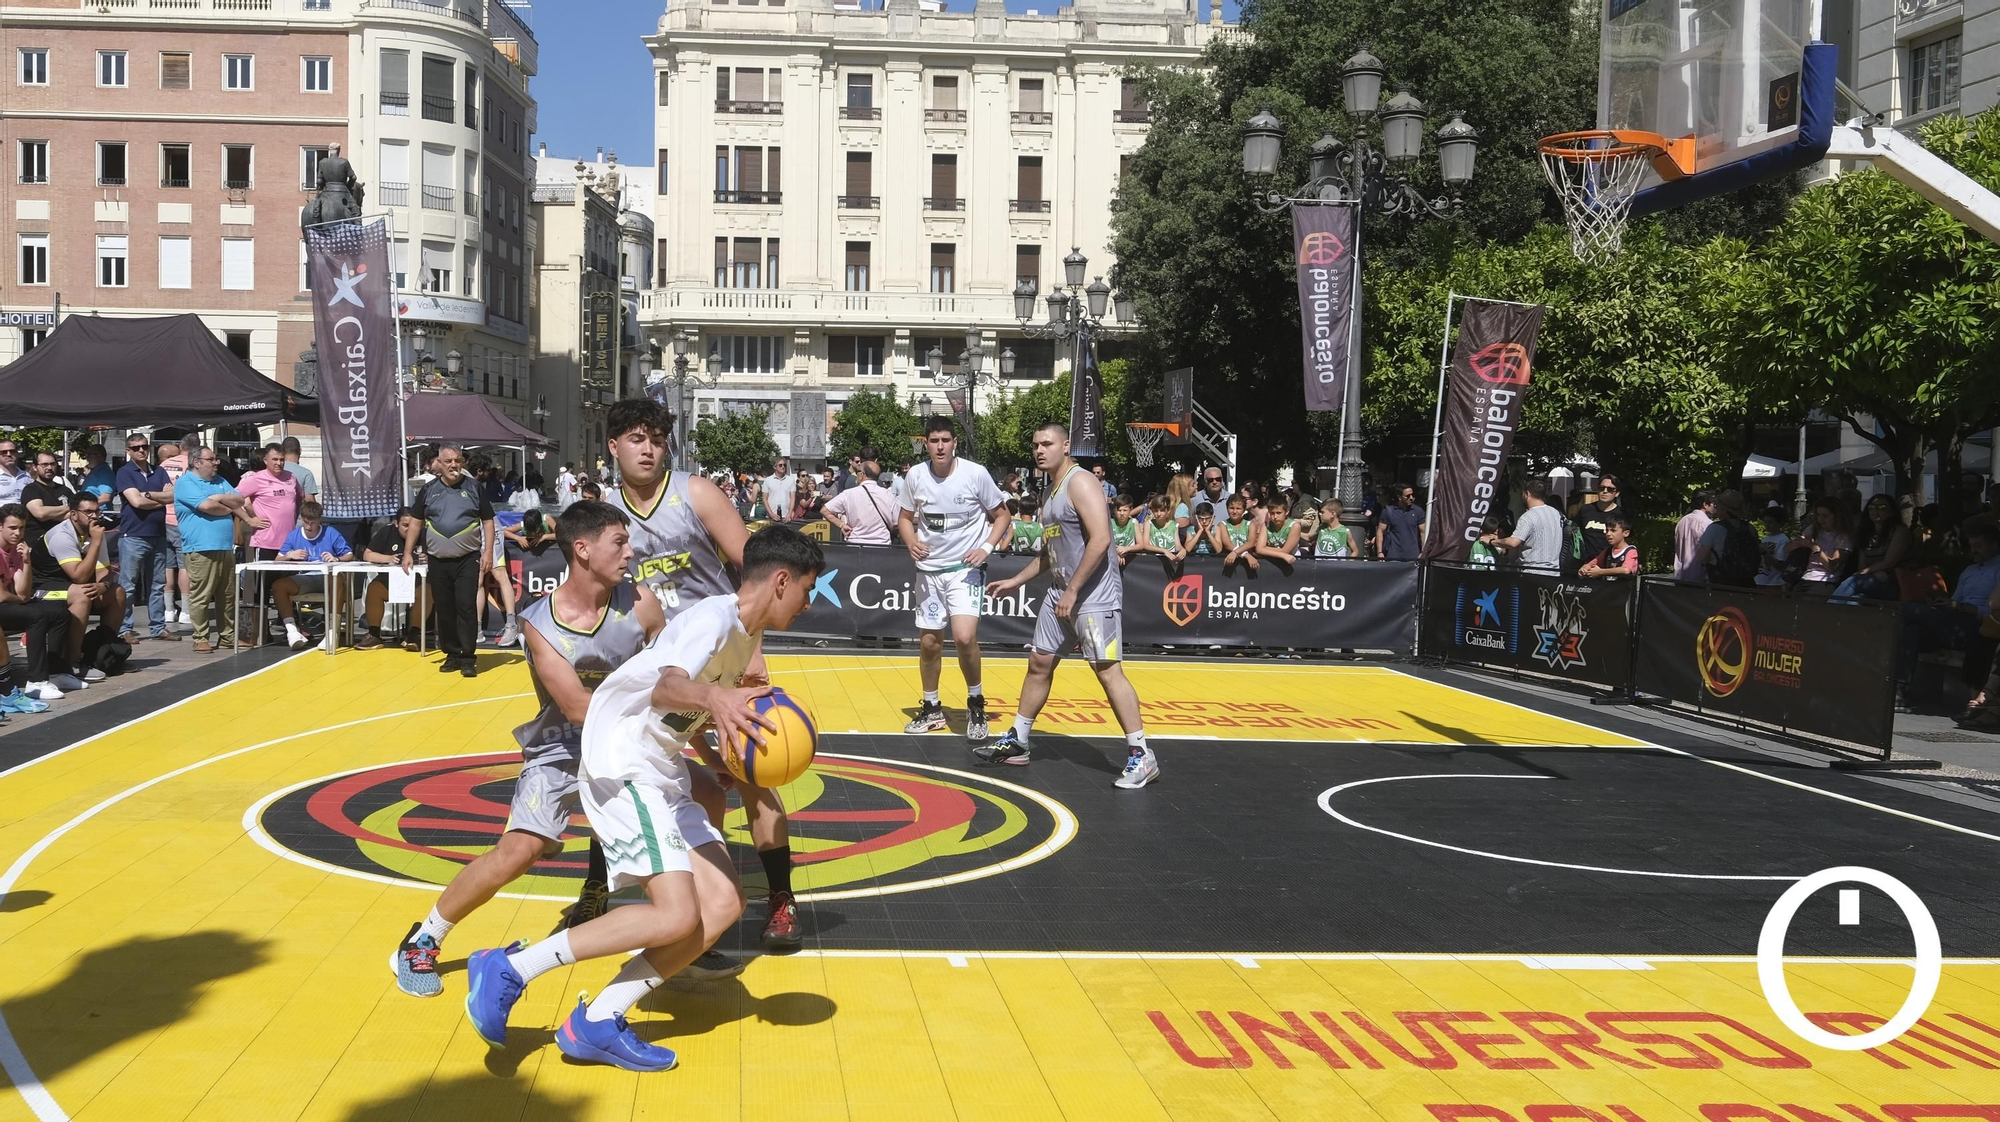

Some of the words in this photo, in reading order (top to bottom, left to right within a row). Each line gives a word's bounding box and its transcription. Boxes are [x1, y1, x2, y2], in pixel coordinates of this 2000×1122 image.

[596, 314, 608, 369] EMFISA
[223, 401, 266, 411] baloncesto
[1469, 388, 1486, 444] ESPAÑA
[793, 435, 824, 449] CIA
[1464, 389, 1516, 542] baloncesto
[1018, 536, 1042, 552] 24
[1322, 540, 1334, 552] 76
[850, 574, 1037, 618] Caiank
[967, 585, 980, 598] 18
[1208, 585, 1346, 612] baloncesto
[1208, 609, 1259, 620] ESPAÑA
[1465, 630, 1506, 650] CaixaBank
[1756, 634, 1804, 654] UNIVERSO
[1754, 650, 1802, 675] MUJER
[1753, 671, 1801, 689] BALONCESTO
[1145, 1011, 1813, 1070] UNIVERSO
